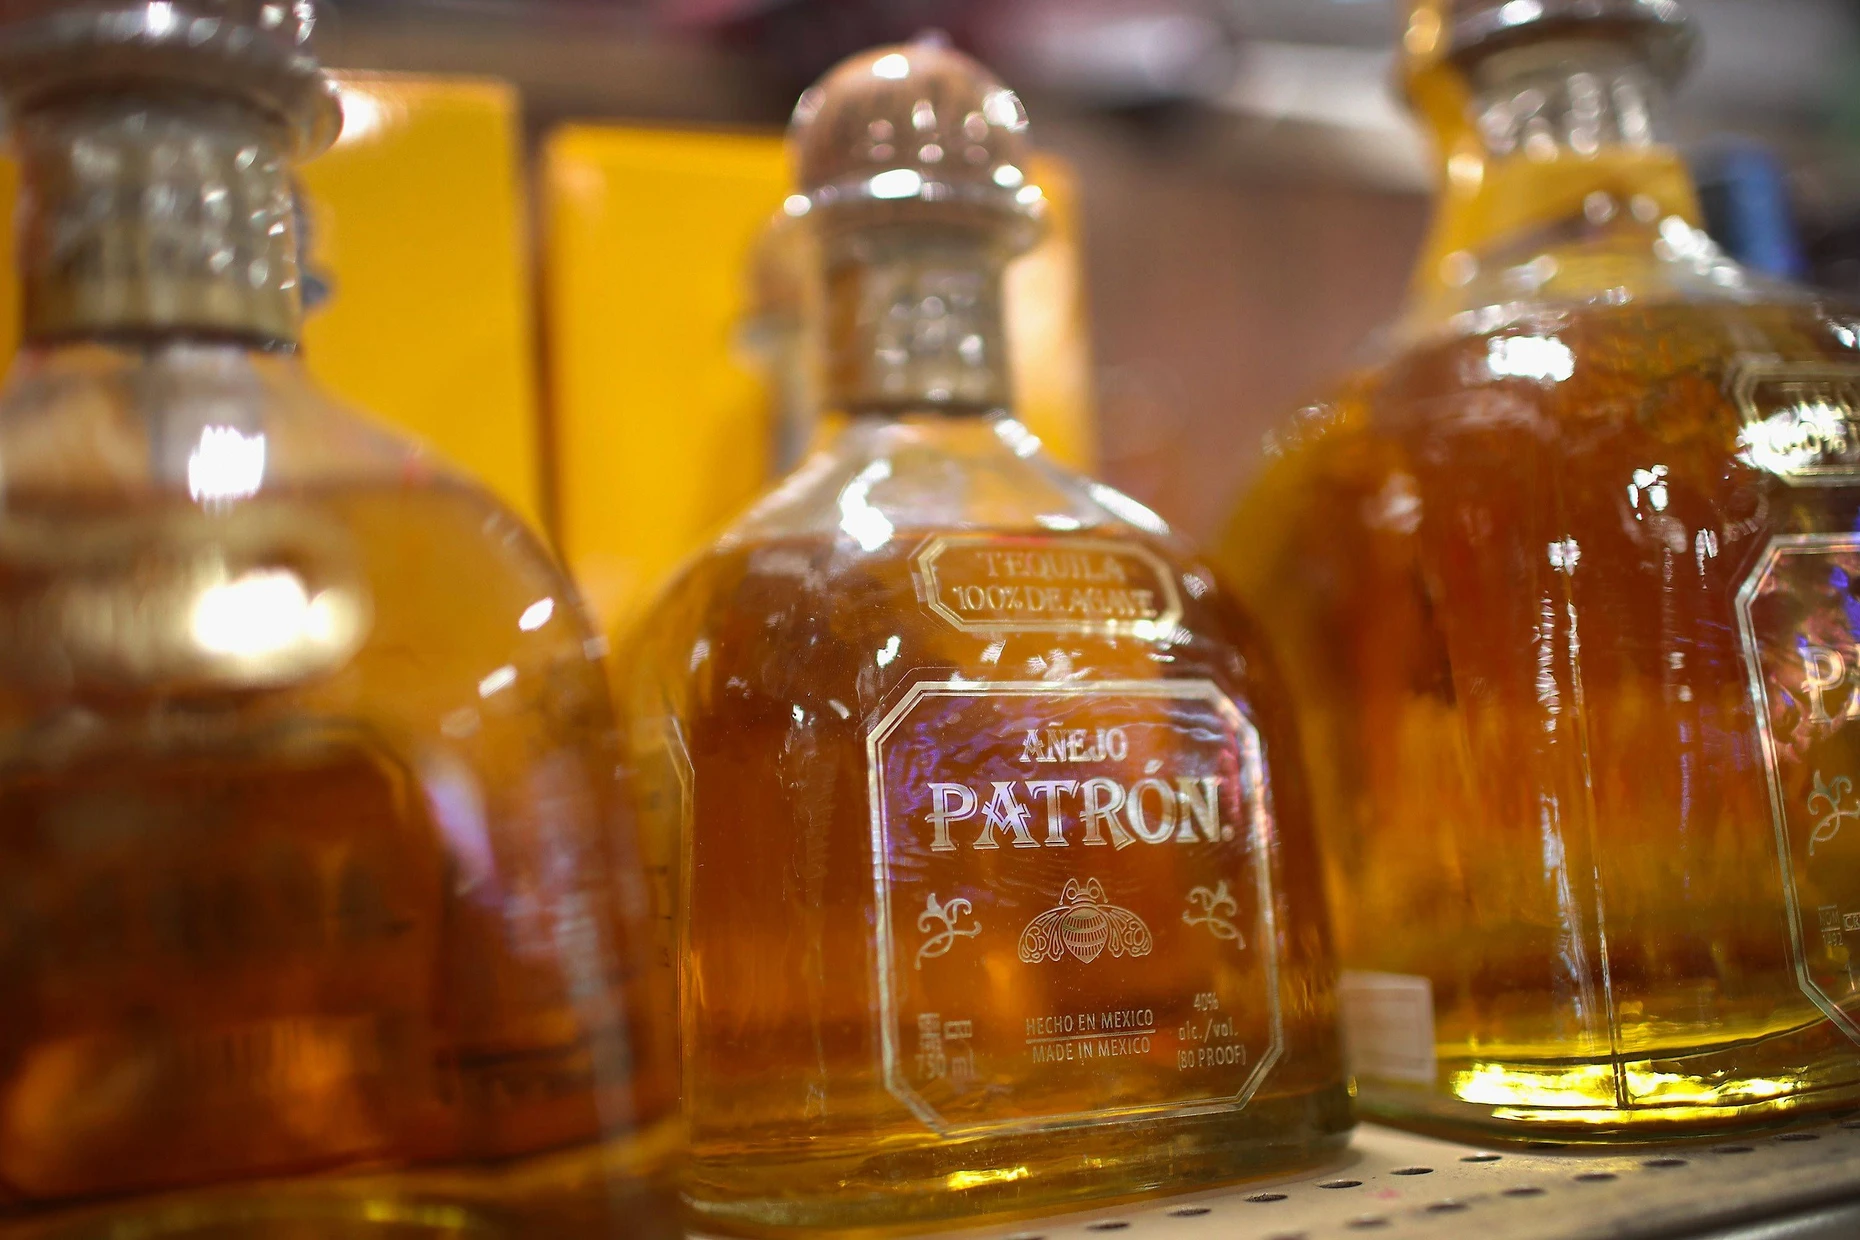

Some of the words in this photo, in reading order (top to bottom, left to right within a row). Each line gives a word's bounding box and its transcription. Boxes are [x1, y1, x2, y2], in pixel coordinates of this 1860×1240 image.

[976, 552, 1128, 582] TEQUILA
[953, 586, 1023, 612] 100%
[1019, 722, 1129, 763] AÑEJO
[1192, 992, 1219, 1012] 40%
[1026, 1014, 1074, 1036] HECHO
[1078, 1012, 1096, 1031] EN
[1101, 1008, 1154, 1030] MEXICO
[1032, 1042, 1074, 1064] MADE
[1078, 1040, 1093, 1060] IN
[1098, 1036, 1151, 1057] MEXICO
[1177, 1050, 1195, 1072] (80
[1199, 1044, 1247, 1068] PROOF)
